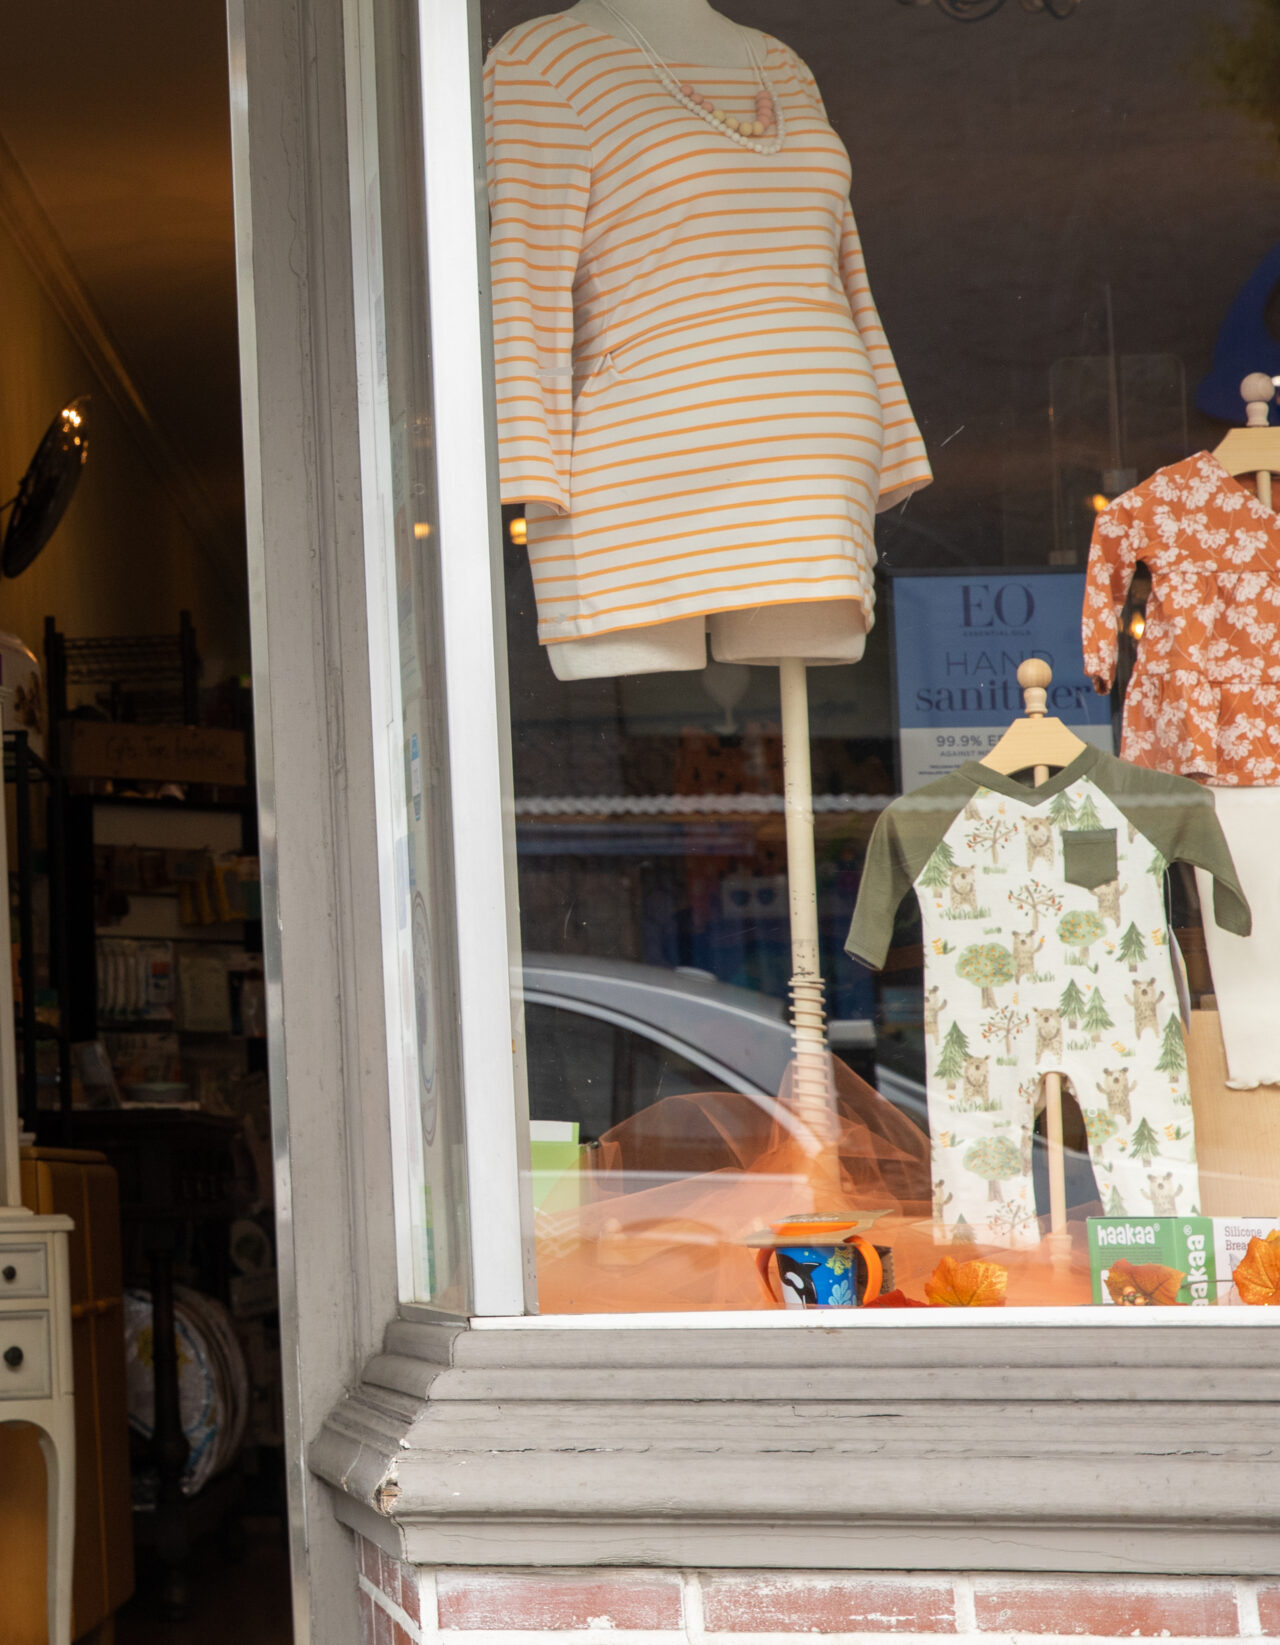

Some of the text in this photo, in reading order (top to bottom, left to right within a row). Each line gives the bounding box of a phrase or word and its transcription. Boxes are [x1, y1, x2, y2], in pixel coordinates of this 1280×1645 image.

[960, 582, 1035, 628] EO
[915, 679, 1092, 712] saniter
[936, 735, 983, 747] 99.9%
[1224, 1226, 1263, 1238] Silicone
[1225, 1240, 1248, 1250] Brea
